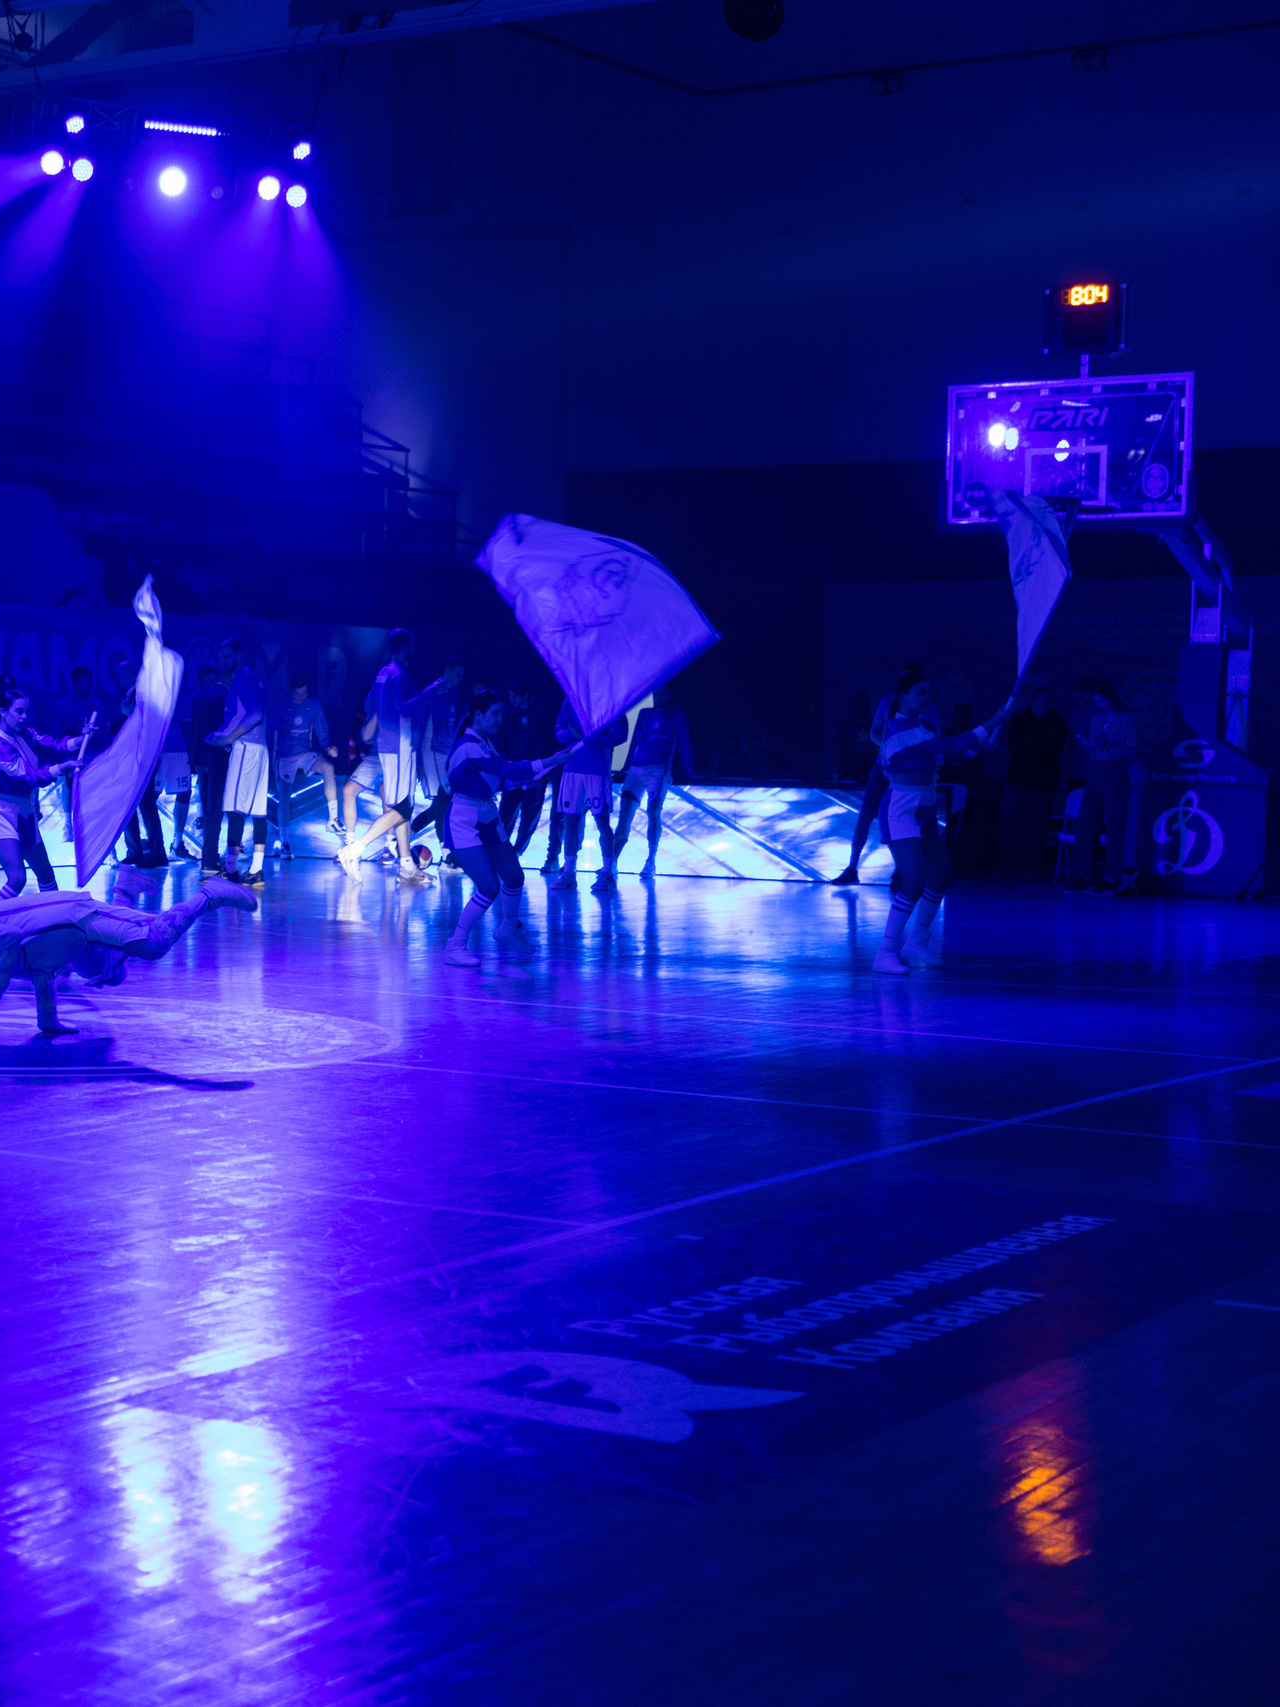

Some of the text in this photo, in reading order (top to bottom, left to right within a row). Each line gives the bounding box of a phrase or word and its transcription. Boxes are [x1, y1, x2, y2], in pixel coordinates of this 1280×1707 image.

[1028, 406, 1109, 430] PARI
[1129, 612, 1189, 625] РОССИ
[176, 776, 189, 788] 15
[1197, 773, 1237, 784] Sports
[669, 1213, 1117, 1354] Рыбопромышленная
[564, 1275, 804, 1338] Русская
[774, 1286, 1046, 1371] Компания
